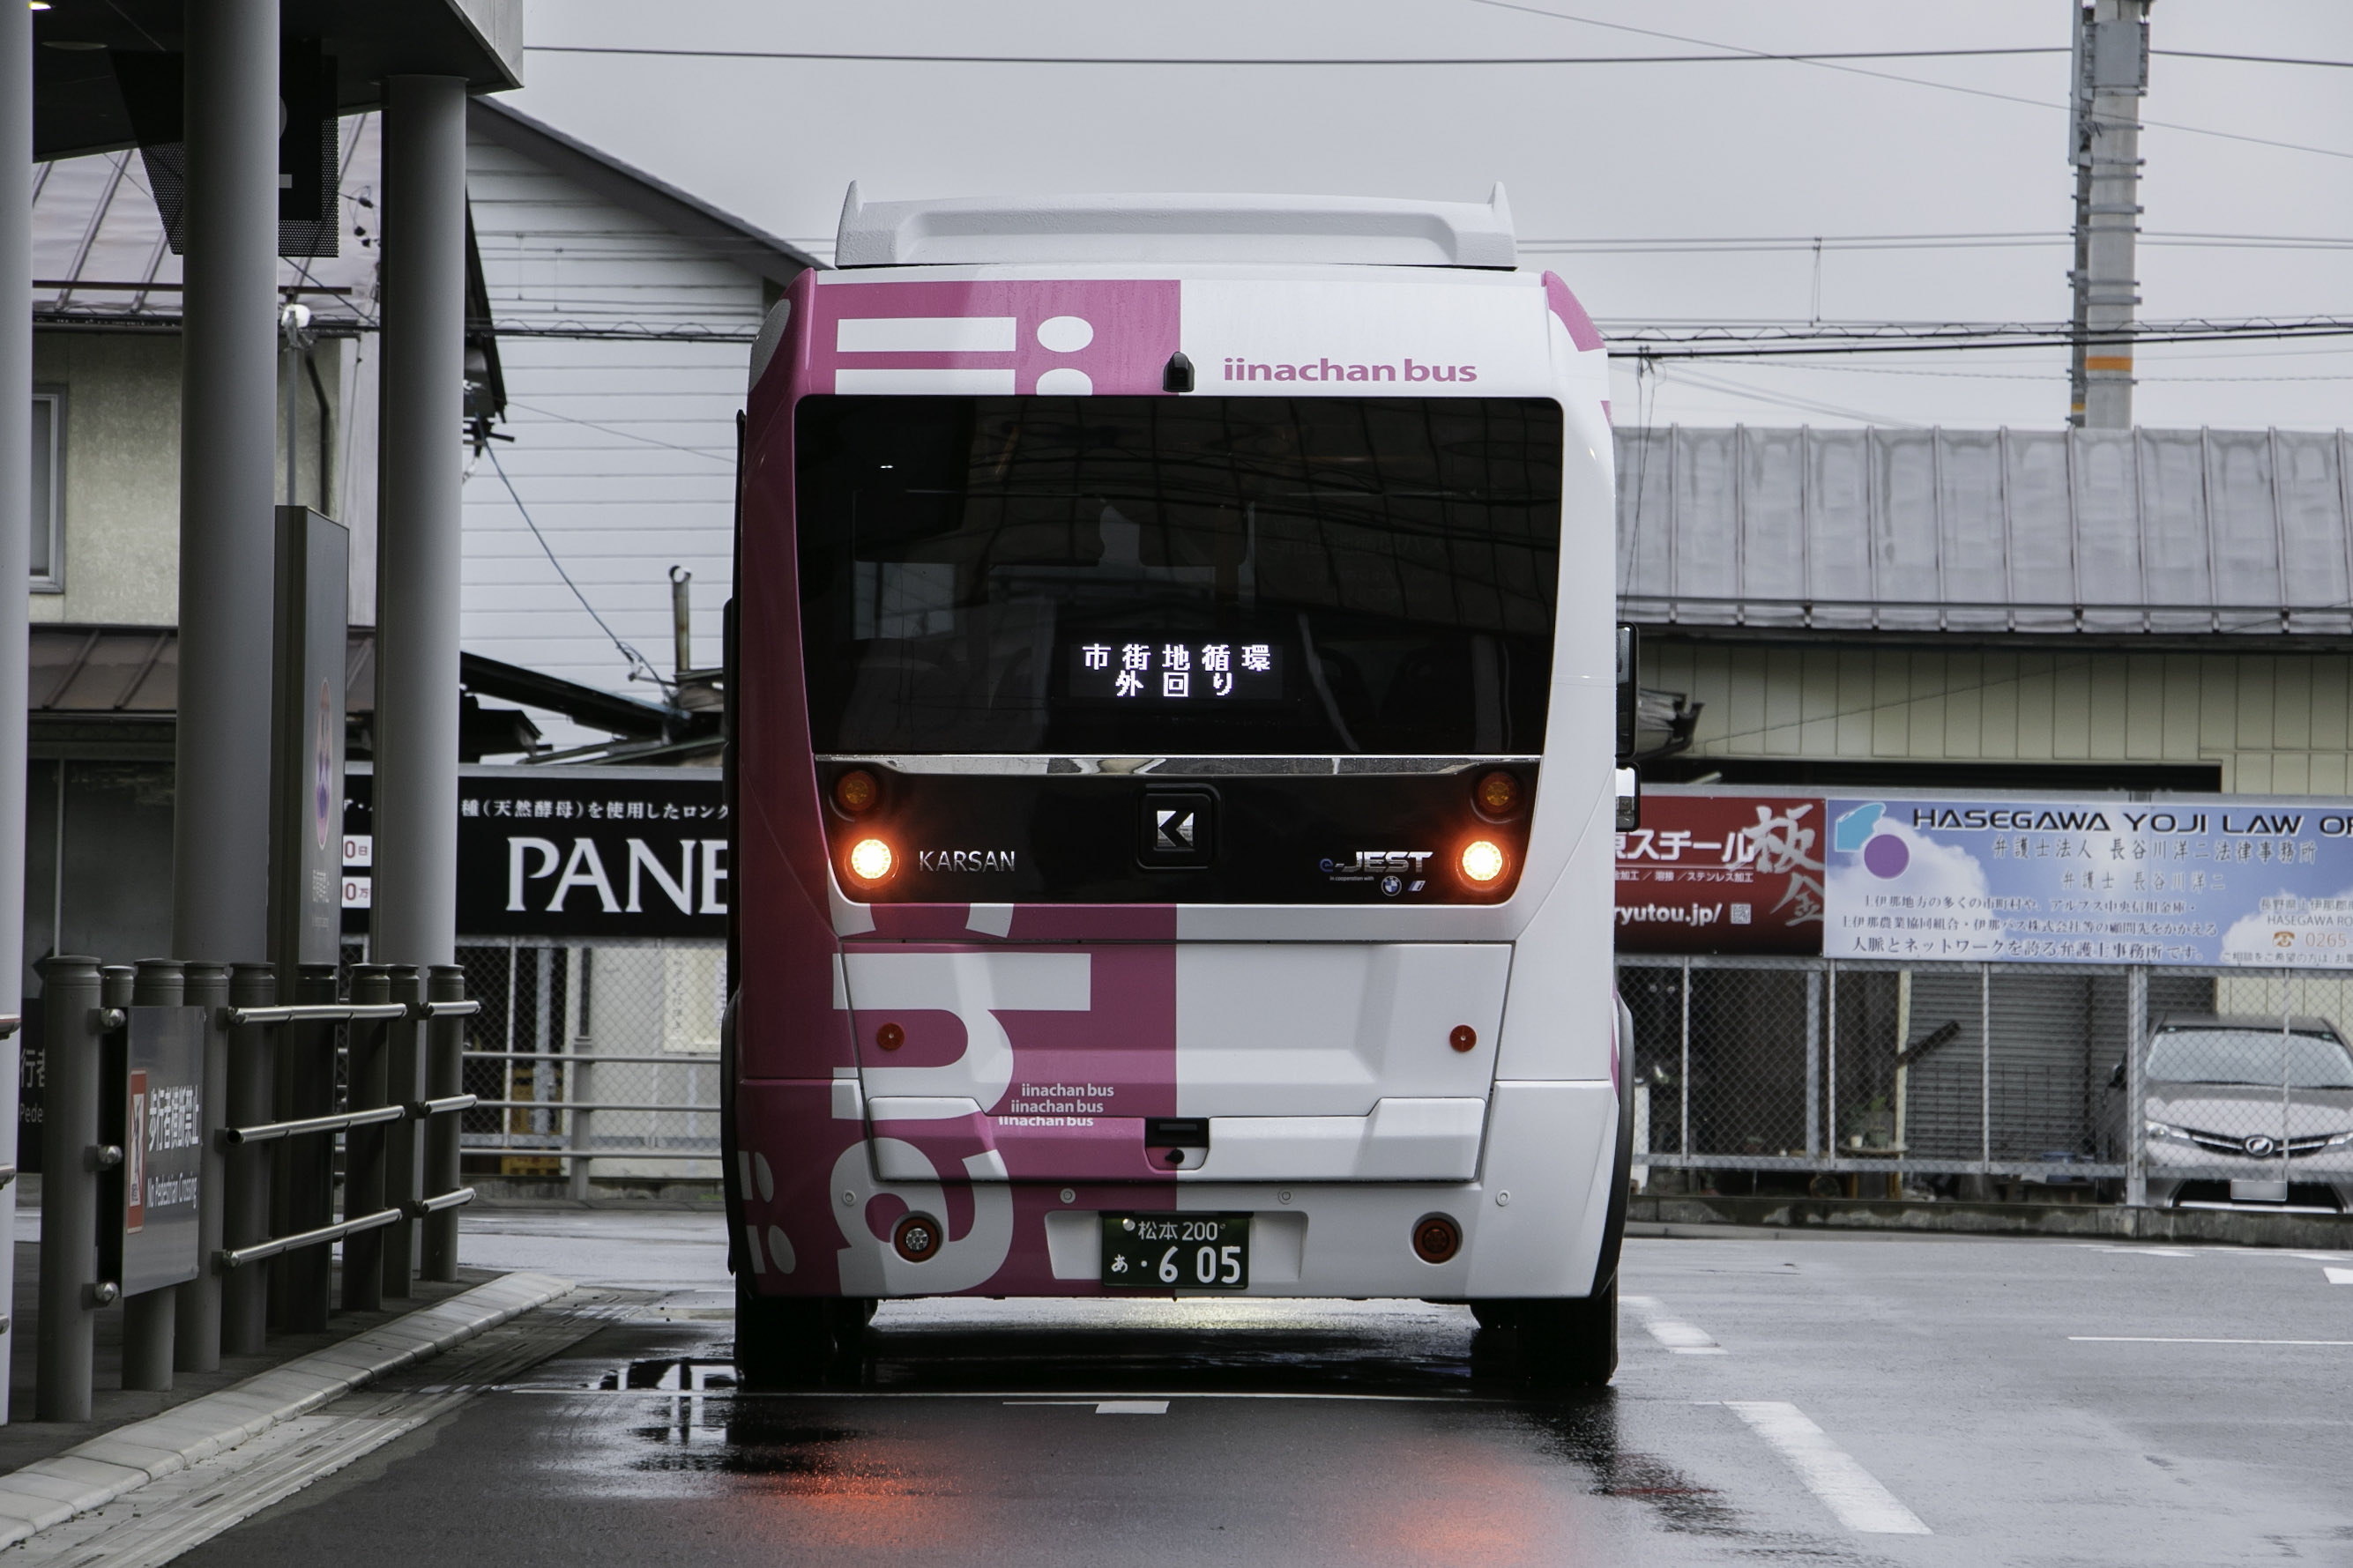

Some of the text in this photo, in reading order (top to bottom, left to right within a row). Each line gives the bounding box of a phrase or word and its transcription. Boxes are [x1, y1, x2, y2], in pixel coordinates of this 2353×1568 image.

[1225, 358, 1478, 382] iinachan bus
[1082, 643, 1271, 672] 市街地循環
[1115, 670, 1232, 697] 外回り
[1913, 808, 2111, 831] HASEGAWA
[2123, 813, 2207, 835] YOJI
[2223, 814, 2302, 836] LAW
[1993, 836, 2318, 864] 弁護士法人 長谷川洋二法律事務所
[920, 851, 1016, 872] KARSAN
[1319, 851, 1434, 873] e-JEST
[505, 836, 728, 916] PANE
[2061, 870, 2226, 890] 弁護士 長谷川洋二
[2267, 915, 2334, 926] HASEGAWA
[1022, 1083, 1114, 1097] iinachan bus
[1011, 1099, 1104, 1113] iinachan bus
[148, 1085, 200, 1153] 歩行者横断禁止
[1067, 1116, 1094, 1126] bus
[1138, 1221, 1218, 1241] 松本 200
[1111, 1254, 1129, 1274] あ
